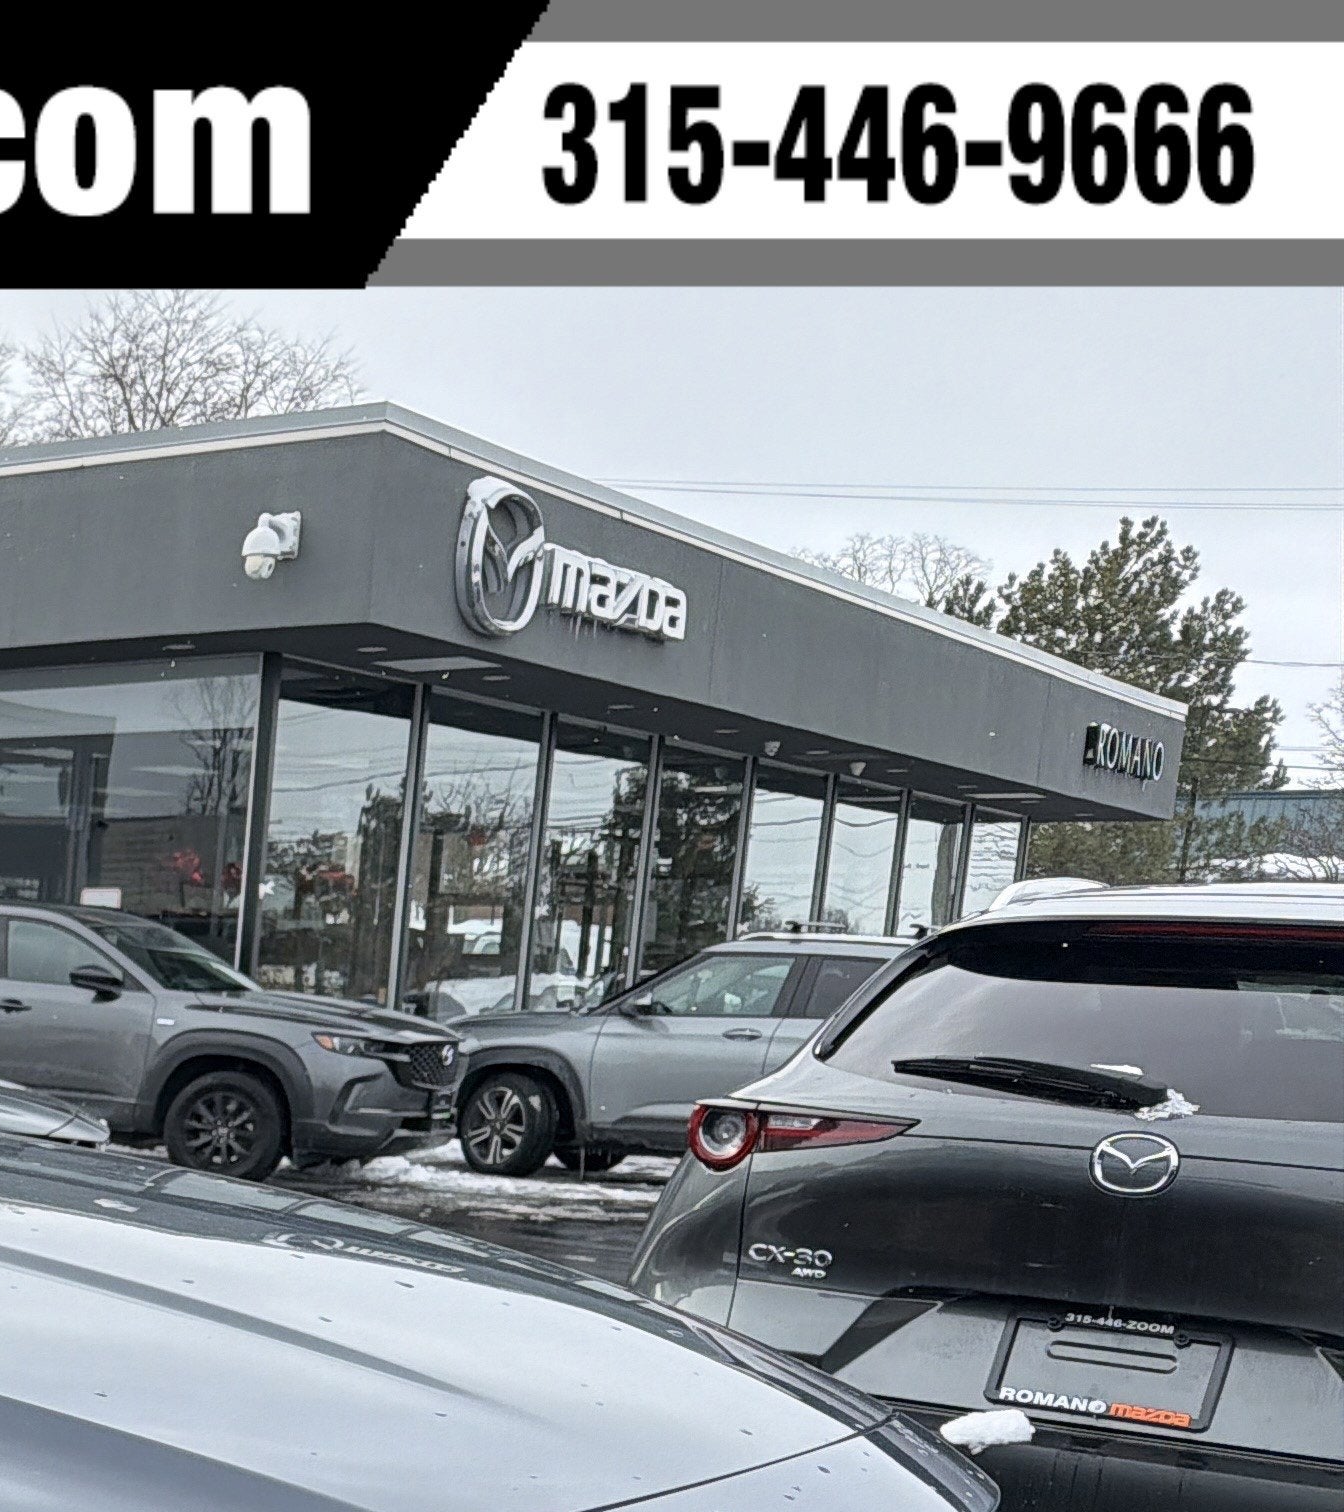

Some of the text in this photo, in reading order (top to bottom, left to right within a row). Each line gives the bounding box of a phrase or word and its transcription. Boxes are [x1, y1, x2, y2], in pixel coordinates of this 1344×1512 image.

[1095, 723, 1165, 781] ROMANO
[748, 1243, 833, 1267] CX-30
[791, 1266, 827, 1279] AWD
[1064, 1312, 1175, 1335] 315-446-ZOOM
[998, 1386, 1108, 1414] ROMANO
